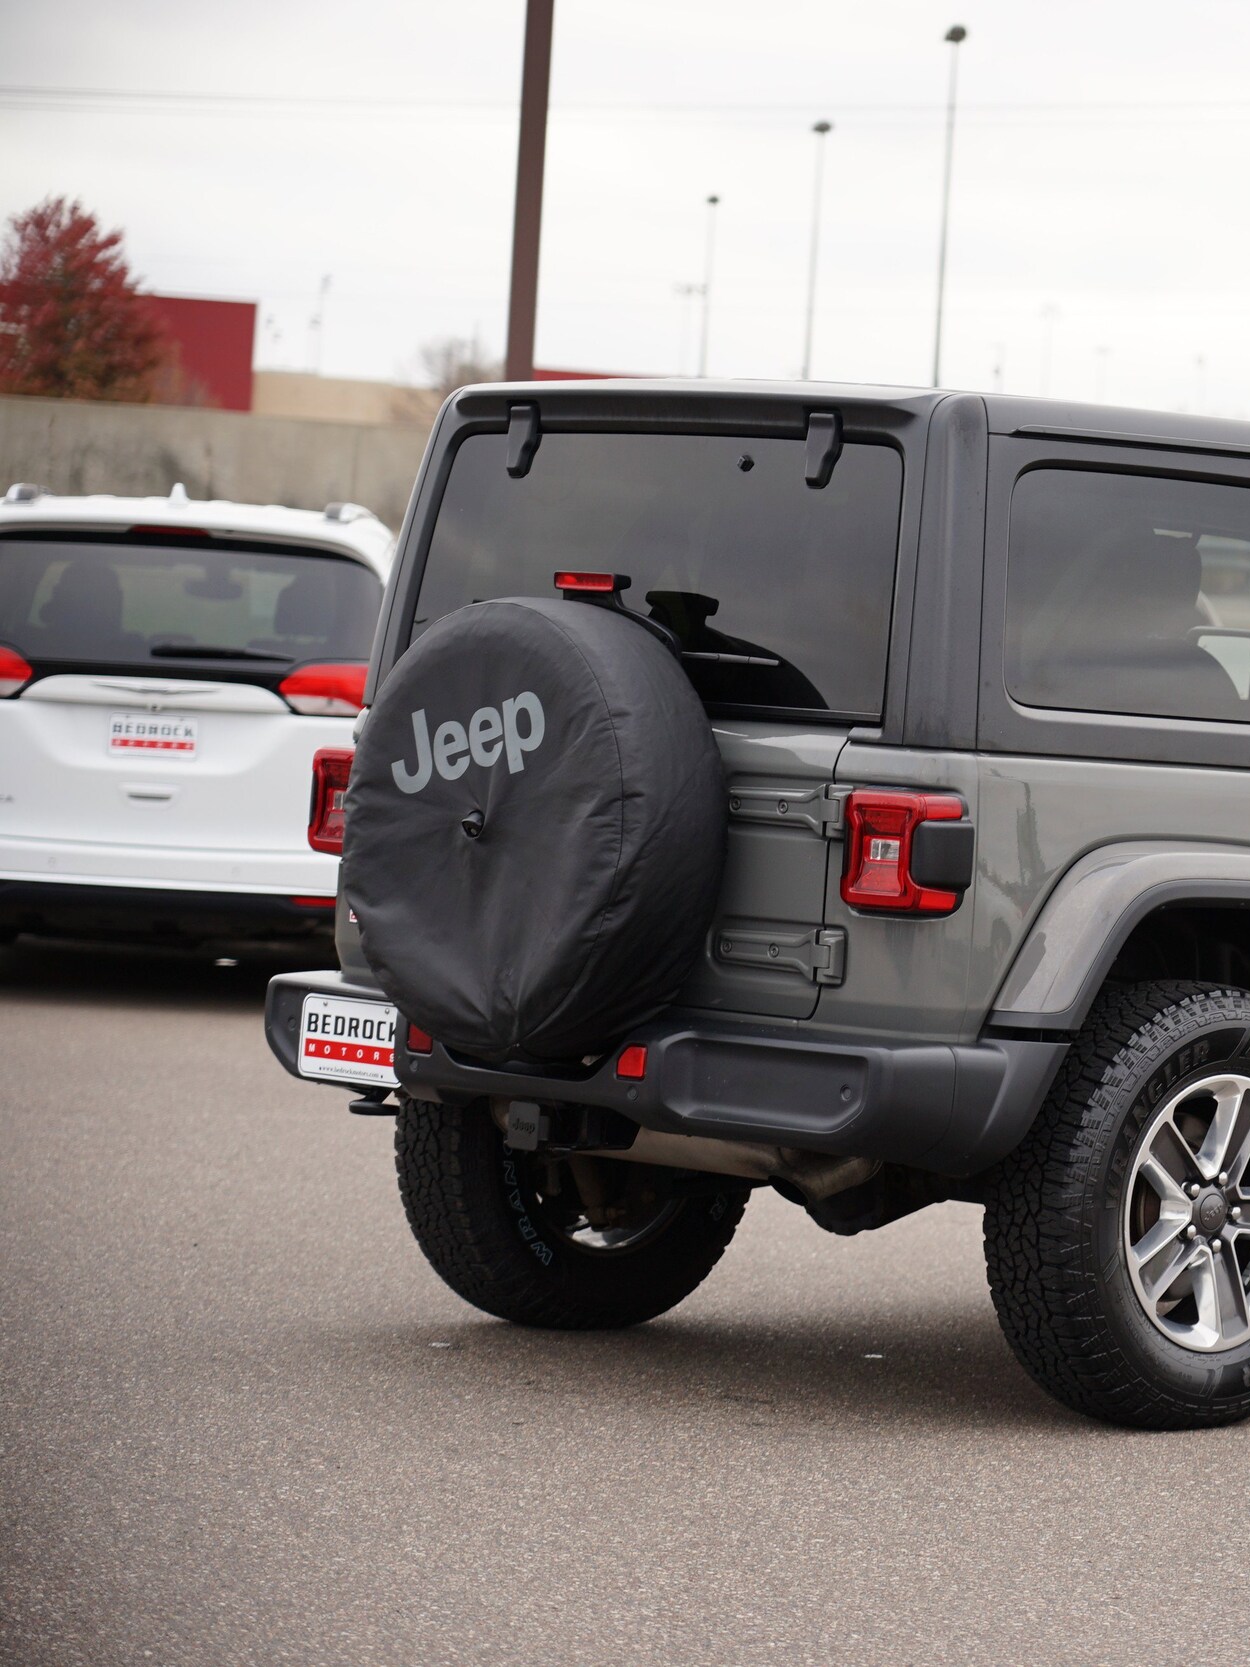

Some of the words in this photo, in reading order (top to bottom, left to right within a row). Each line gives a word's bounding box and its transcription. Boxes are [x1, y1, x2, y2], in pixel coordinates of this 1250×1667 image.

[391, 691, 545, 794] Jeep
[306, 1012, 396, 1042] BEDROCK
[308, 1042, 395, 1063] MOTORS
